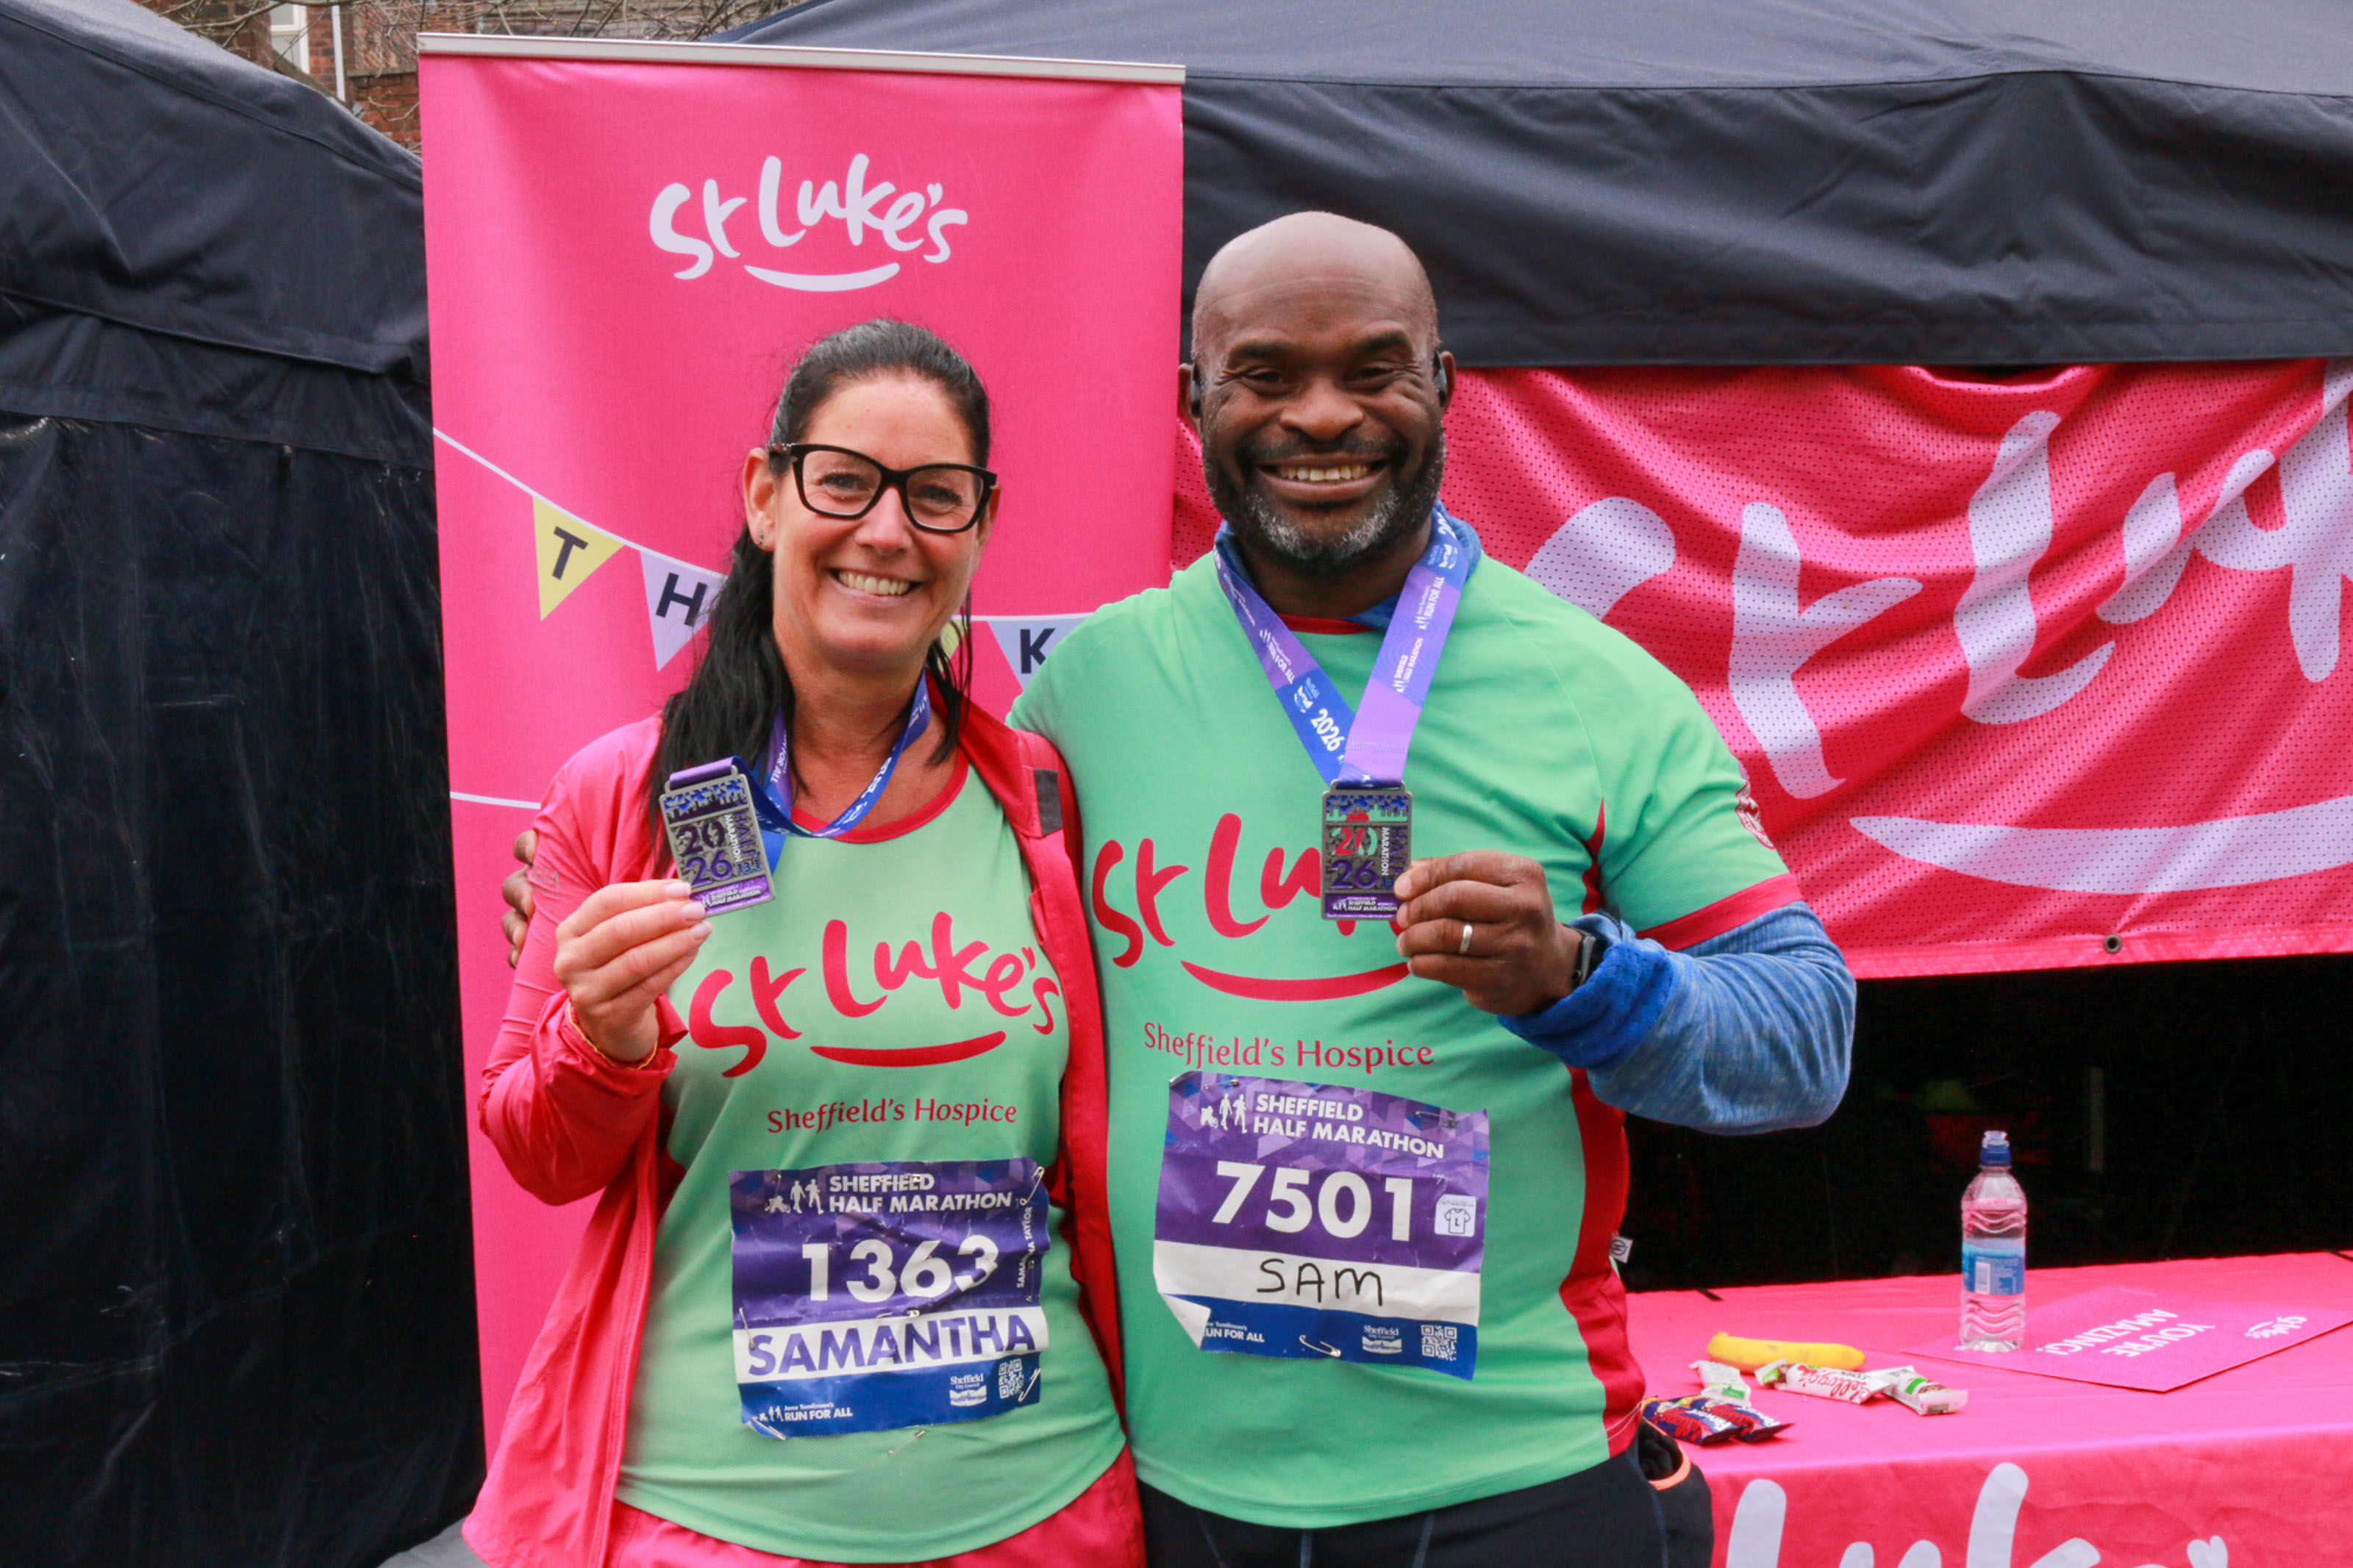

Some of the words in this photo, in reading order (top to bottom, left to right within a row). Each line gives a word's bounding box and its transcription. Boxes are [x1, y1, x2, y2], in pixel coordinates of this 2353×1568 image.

[649, 179, 747, 279] St
[758, 153, 968, 263] Luke's
[1432, 576, 1445, 589] ALL
[1284, 667, 1295, 684] ALL
[1310, 708, 1346, 751] 2026
[770, 765, 782, 783] ALL
[676, 820, 726, 857] 20
[724, 814, 742, 862] MARATHON
[731, 809, 757, 858] HALF
[1330, 827, 1378, 856] 20
[1380, 827, 1390, 876] MARATHON
[1390, 827, 1406, 876] HALF
[685, 850, 733, 887] 26
[737, 859, 761, 876] 13.1
[1330, 859, 1377, 889] 26
[1092, 838, 1189, 968] St
[688, 956, 807, 1077] St
[822, 912, 1060, 1035] Luke's
[1144, 1022, 1285, 1070] Sheffield's
[1296, 1039, 1435, 1074] Hospice
[768, 1098, 904, 1134] Sheffield's
[915, 1098, 1017, 1126] Hospice
[1256, 1093, 1363, 1122] SHEFFIELD
[1253, 1115, 1307, 1136] HALF
[1311, 1123, 1444, 1159] MARATHON
[829, 1174, 935, 1192] SHEFFIELD
[1212, 1160, 1413, 1242] 7501
[829, 1196, 882, 1213] HALF
[890, 1192, 1013, 1213] MARATHON
[1022, 1206, 1033, 1241] TAYLOR
[1454, 1217, 1460, 1227] L
[802, 1234, 998, 1303] 1363
[1257, 1258, 1383, 1307] SAM
[749, 1314, 1036, 1376] SAMANTHA
[1203, 1328, 1223, 1338] UN
[1224, 1329, 1245, 1341] FOR
[1246, 1332, 1265, 1344] ALL
[2035, 1308, 2179, 1356] AMAZING!
[2102, 1323, 2216, 1358] YOU'RE
[784, 1411, 808, 1422] RUN
[810, 1409, 832, 1420] FOR
[833, 1406, 854, 1418] ALL
